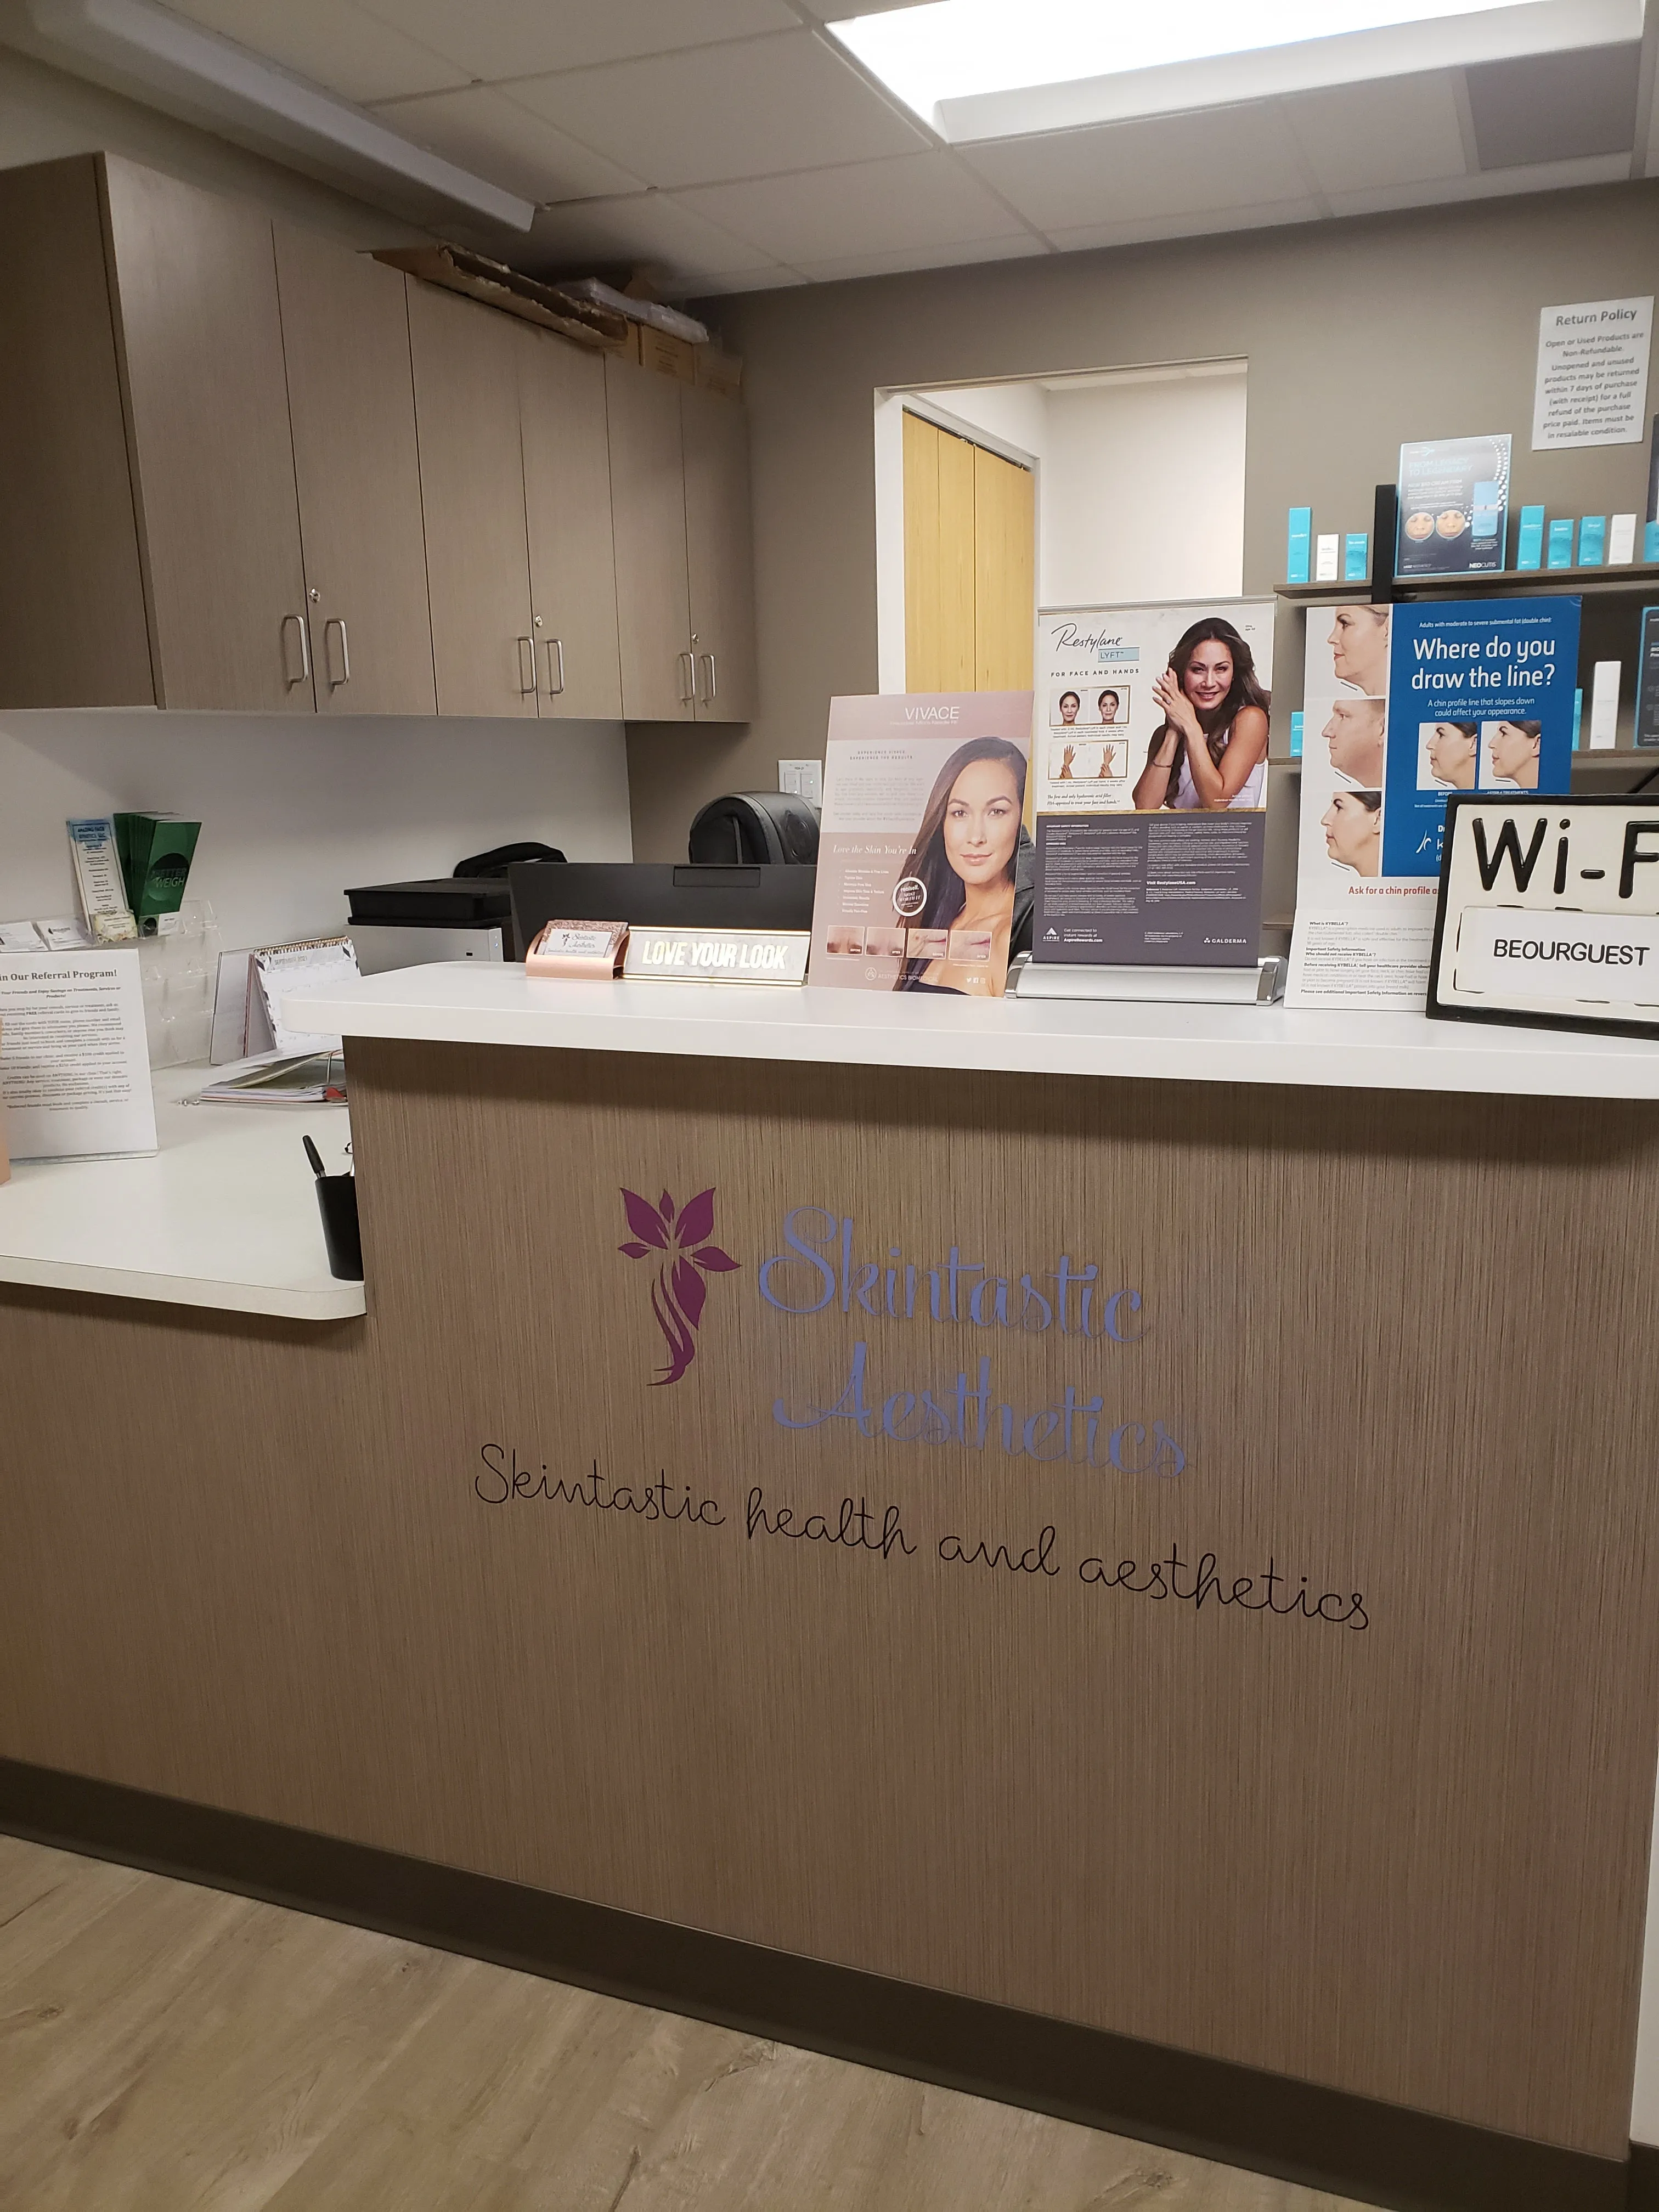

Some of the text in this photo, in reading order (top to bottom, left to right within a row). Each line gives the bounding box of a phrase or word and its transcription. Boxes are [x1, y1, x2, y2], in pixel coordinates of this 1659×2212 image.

[1556, 308, 1637, 326] Return Policy
[1598, 334, 1630, 342] Products
[1551, 361, 1589, 371] Unopened
[1607, 357, 1634, 365] unused
[1544, 375, 1576, 384] products
[1607, 368, 1639, 377] returned
[1604, 381, 1638, 390] purchase
[1549, 398, 1568, 406] (with
[1570, 394, 1598, 403] receipt)
[1548, 408, 1572, 417] refund
[1597, 404, 1630, 414] purchase
[1543, 421, 1561, 430] price
[1556, 430, 1589, 438] resalable
[1591, 427, 1627, 436] condition.
[1413, 635, 1555, 663] Where do you
[1412, 663, 1555, 690] draw the line?
[1448, 698, 1468, 708] profile
[1494, 697, 1515, 707] slopes
[905, 706, 960, 720] VIVACE
[1453, 708, 1471, 716] affect
[1472, 709, 1486, 718] your
[1488, 708, 1527, 716] appearance.
[833, 845, 850, 854] Love
[851, 845, 862, 854] the
[865, 844, 881, 854] Skin
[155, 877, 185, 888] WEIGH
[1348, 887, 1364, 895] Ask
[1366, 886, 1378, 895] for
[1386, 886, 1402, 895] chin
[1403, 886, 1430, 896] profile
[642, 940, 789, 969] LOVE YOUR LOOK
[1493, 939, 1650, 966] BEOURGUEST
[31, 970, 70, 979] Referral
[72, 969, 117, 979] Program!
[758, 1205, 1151, 1342] Skintastic
[772, 1340, 1189, 1479] Aesthetics
[473, 1443, 1370, 1631] Skintastic health and aesthetics
